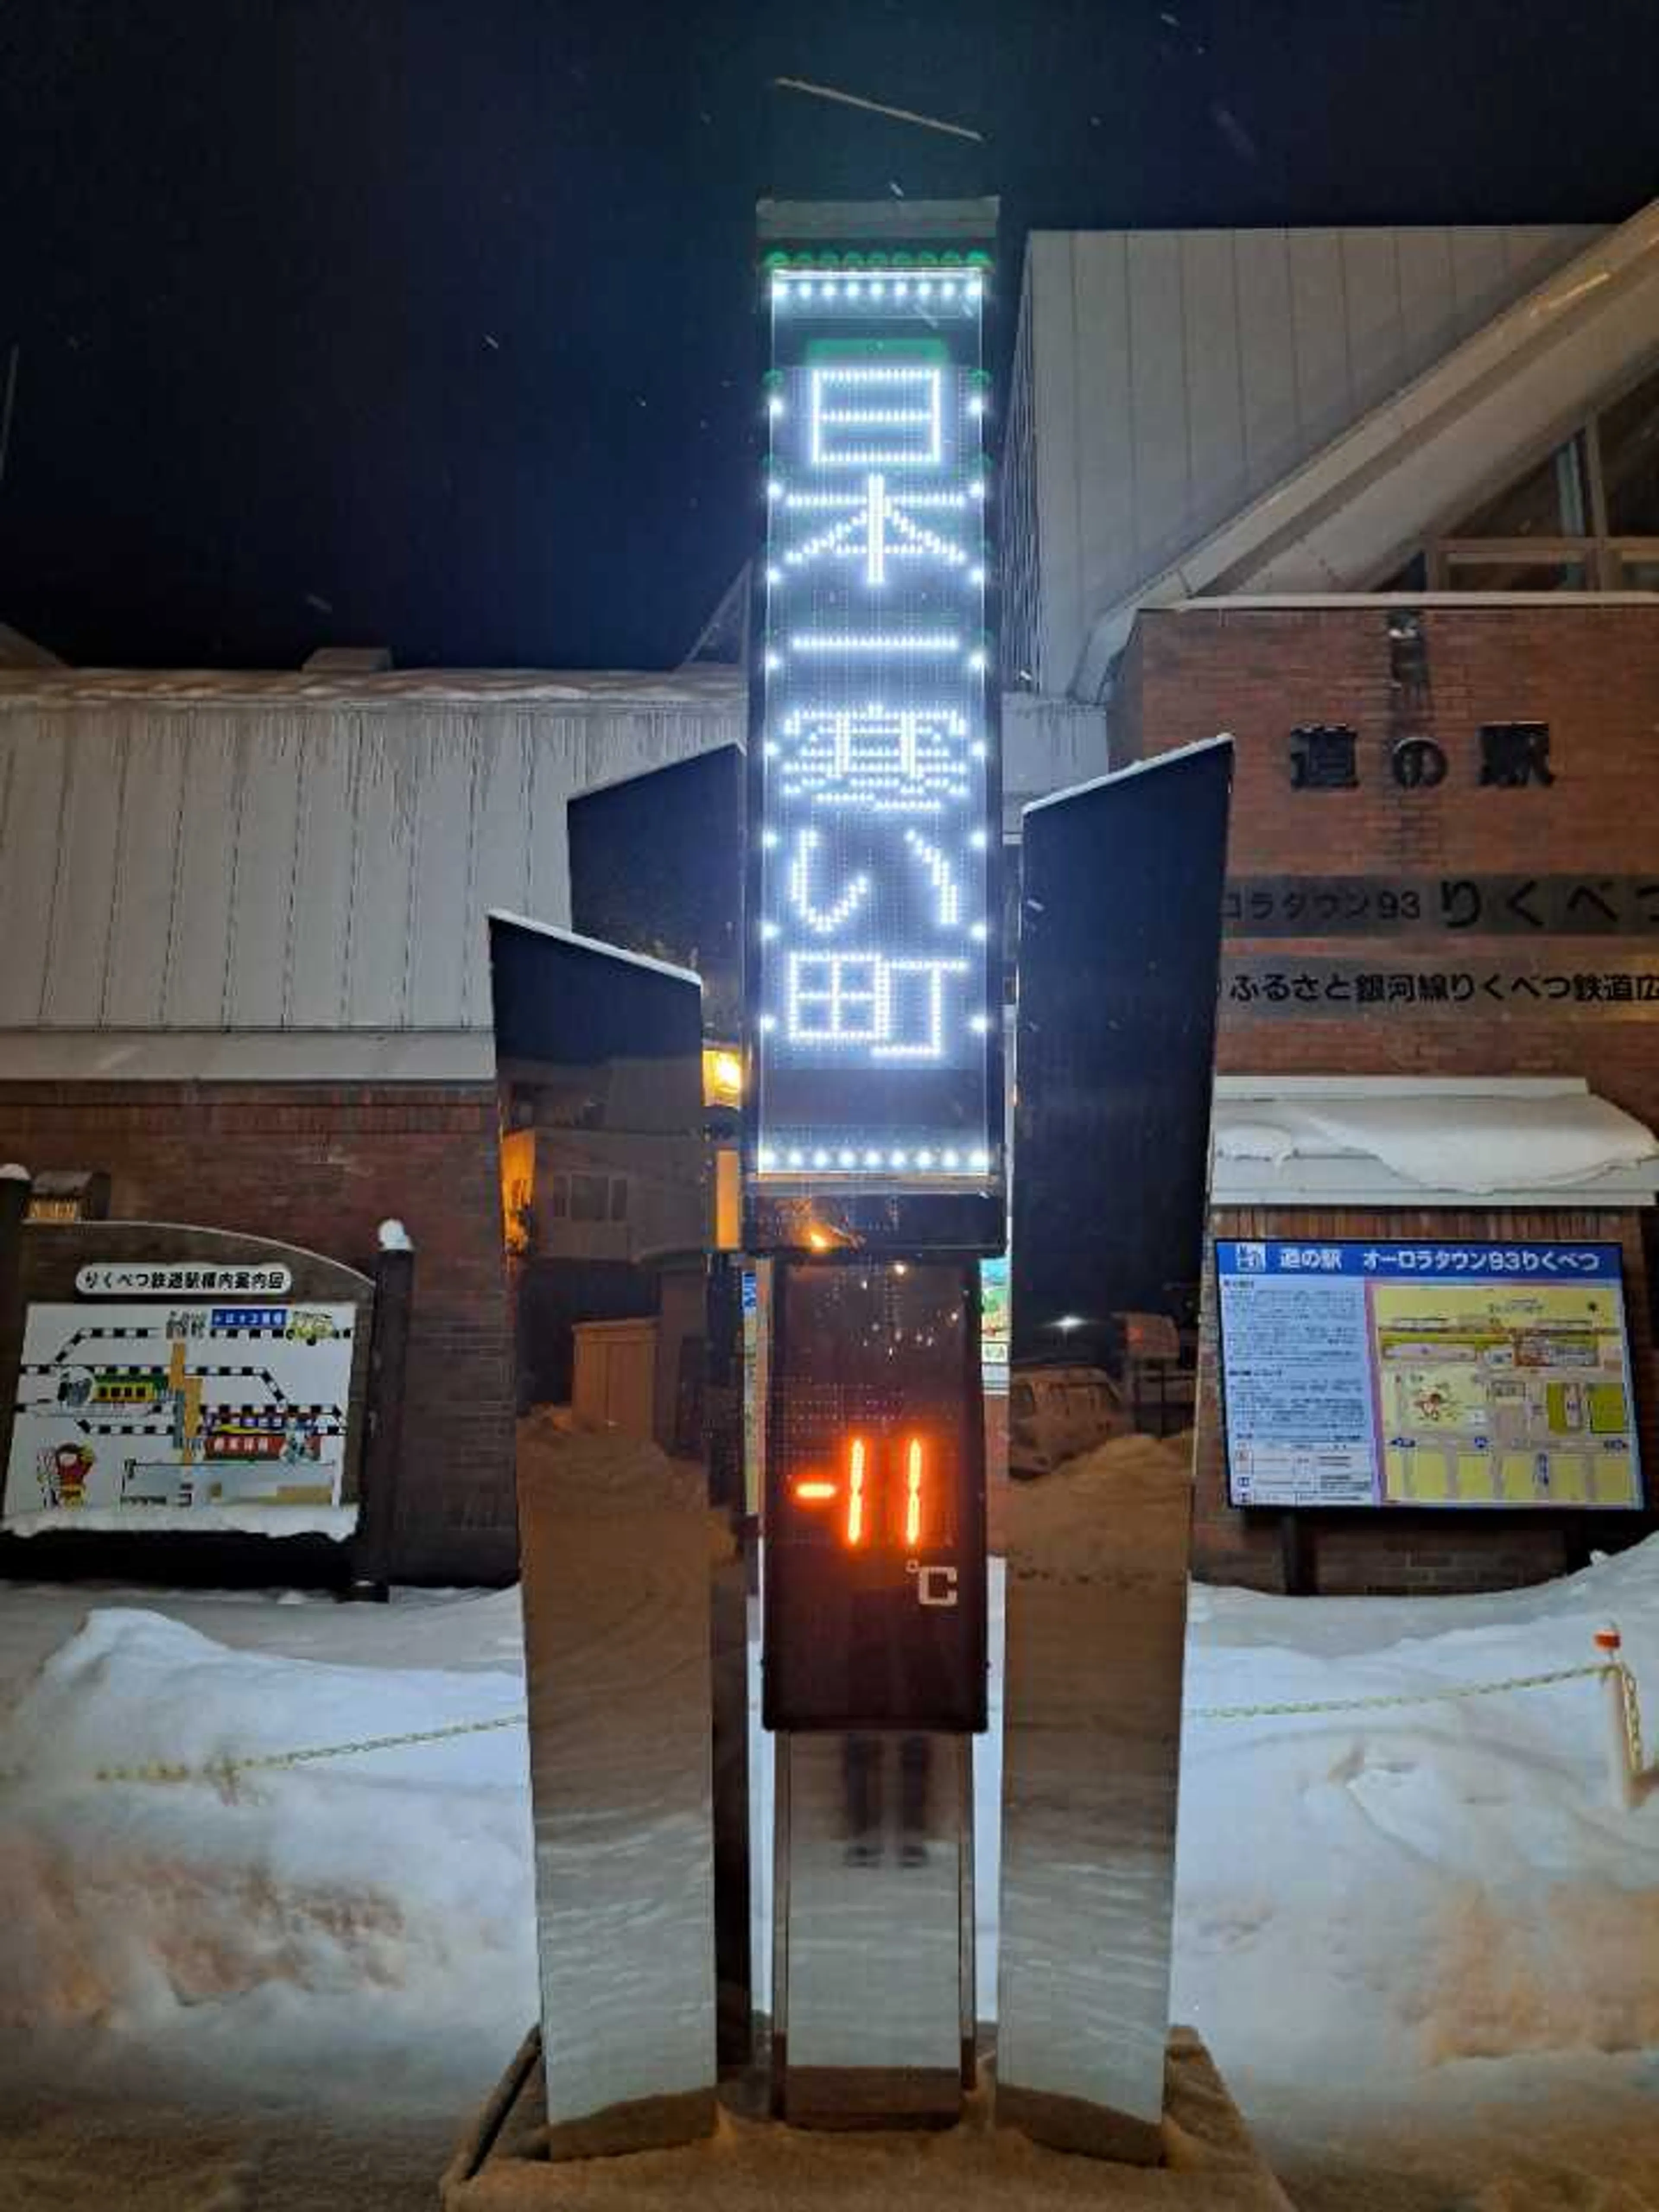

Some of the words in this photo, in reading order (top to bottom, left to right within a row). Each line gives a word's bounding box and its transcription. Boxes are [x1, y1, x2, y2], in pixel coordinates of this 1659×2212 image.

[781, 368, 970, 1058] 日本一寒い町
[1290, 721, 1555, 789] 道の駅
[1280, 1248, 1341, 1269] 道の駅
